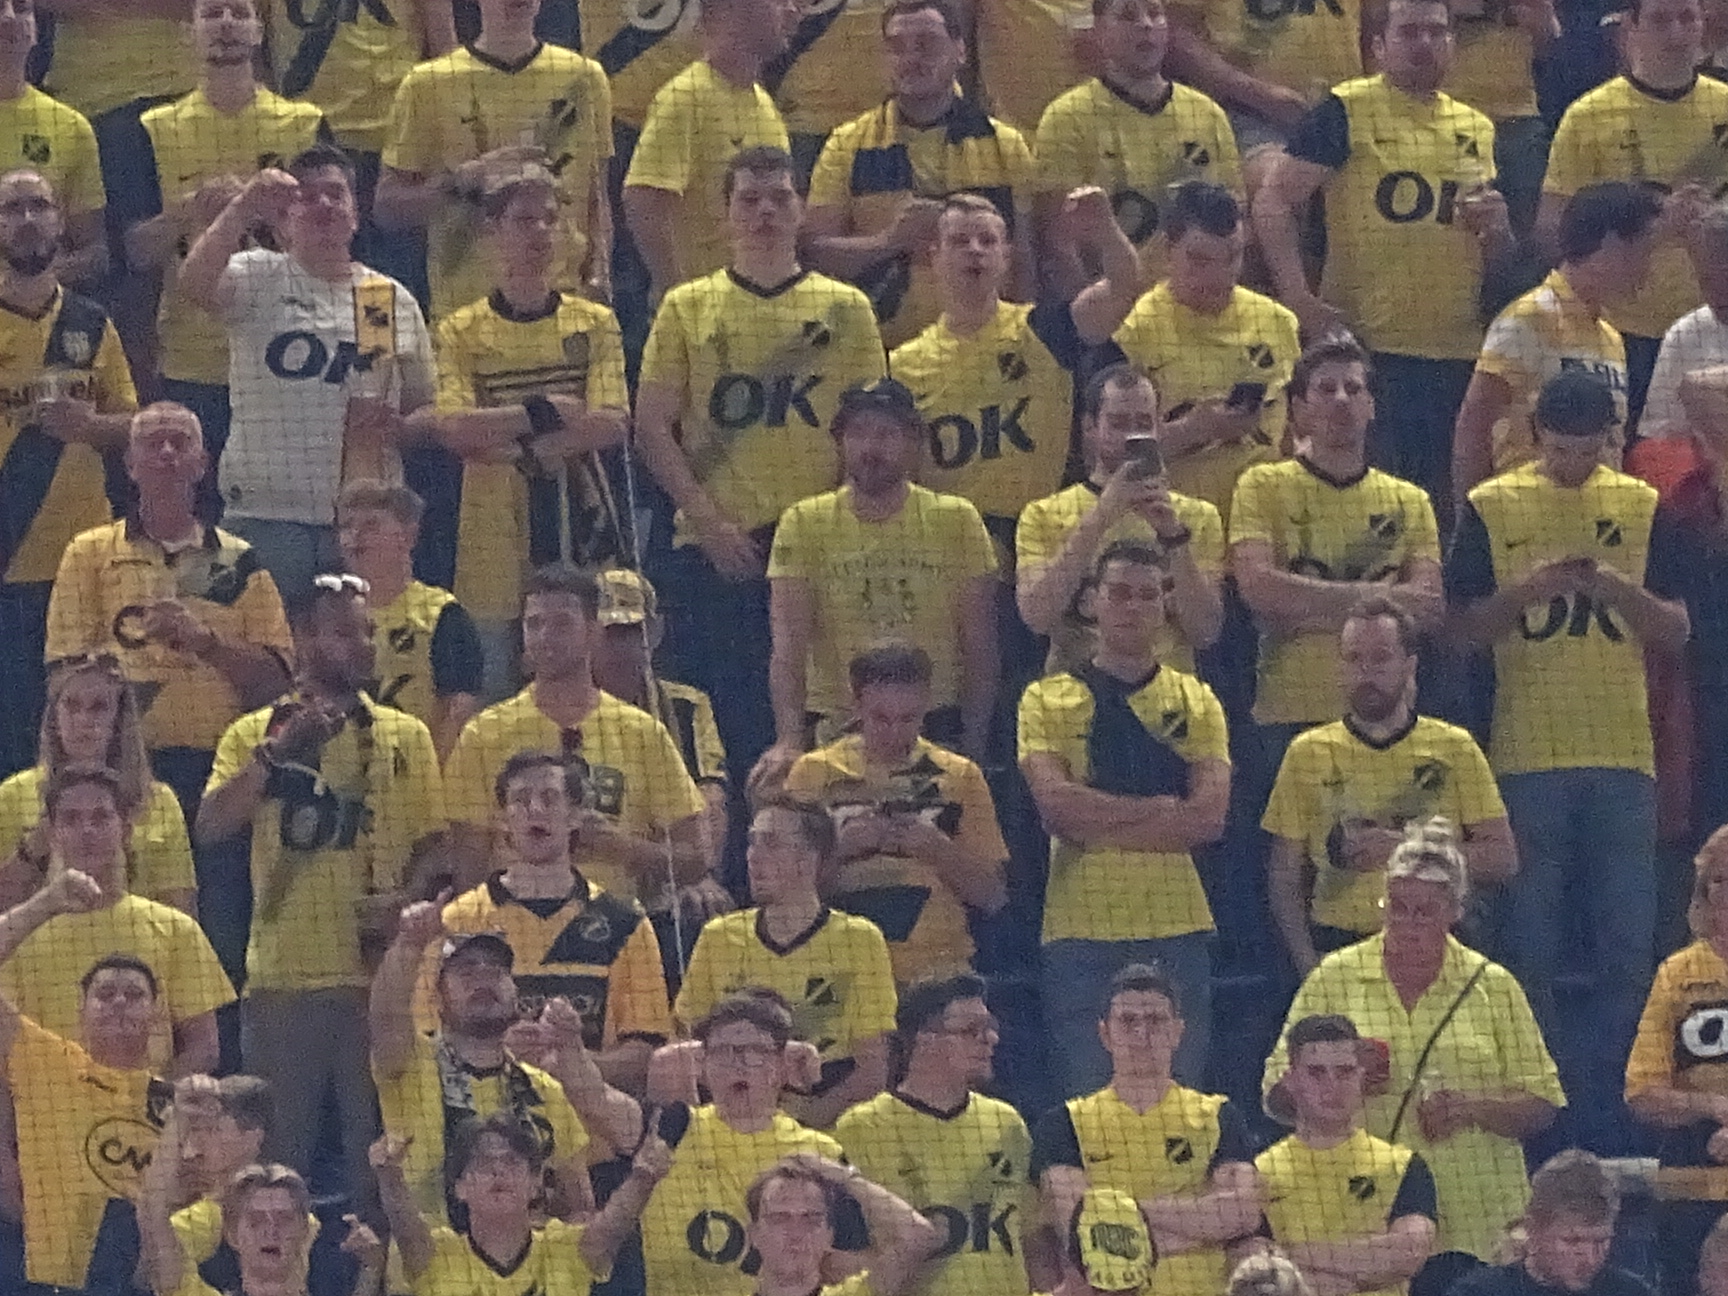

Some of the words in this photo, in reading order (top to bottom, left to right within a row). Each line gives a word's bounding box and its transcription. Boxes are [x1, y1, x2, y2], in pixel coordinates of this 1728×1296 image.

[711, 374, 822, 429] OK
[928, 397, 1035, 470] OK
[1517, 588, 1625, 642] OK
